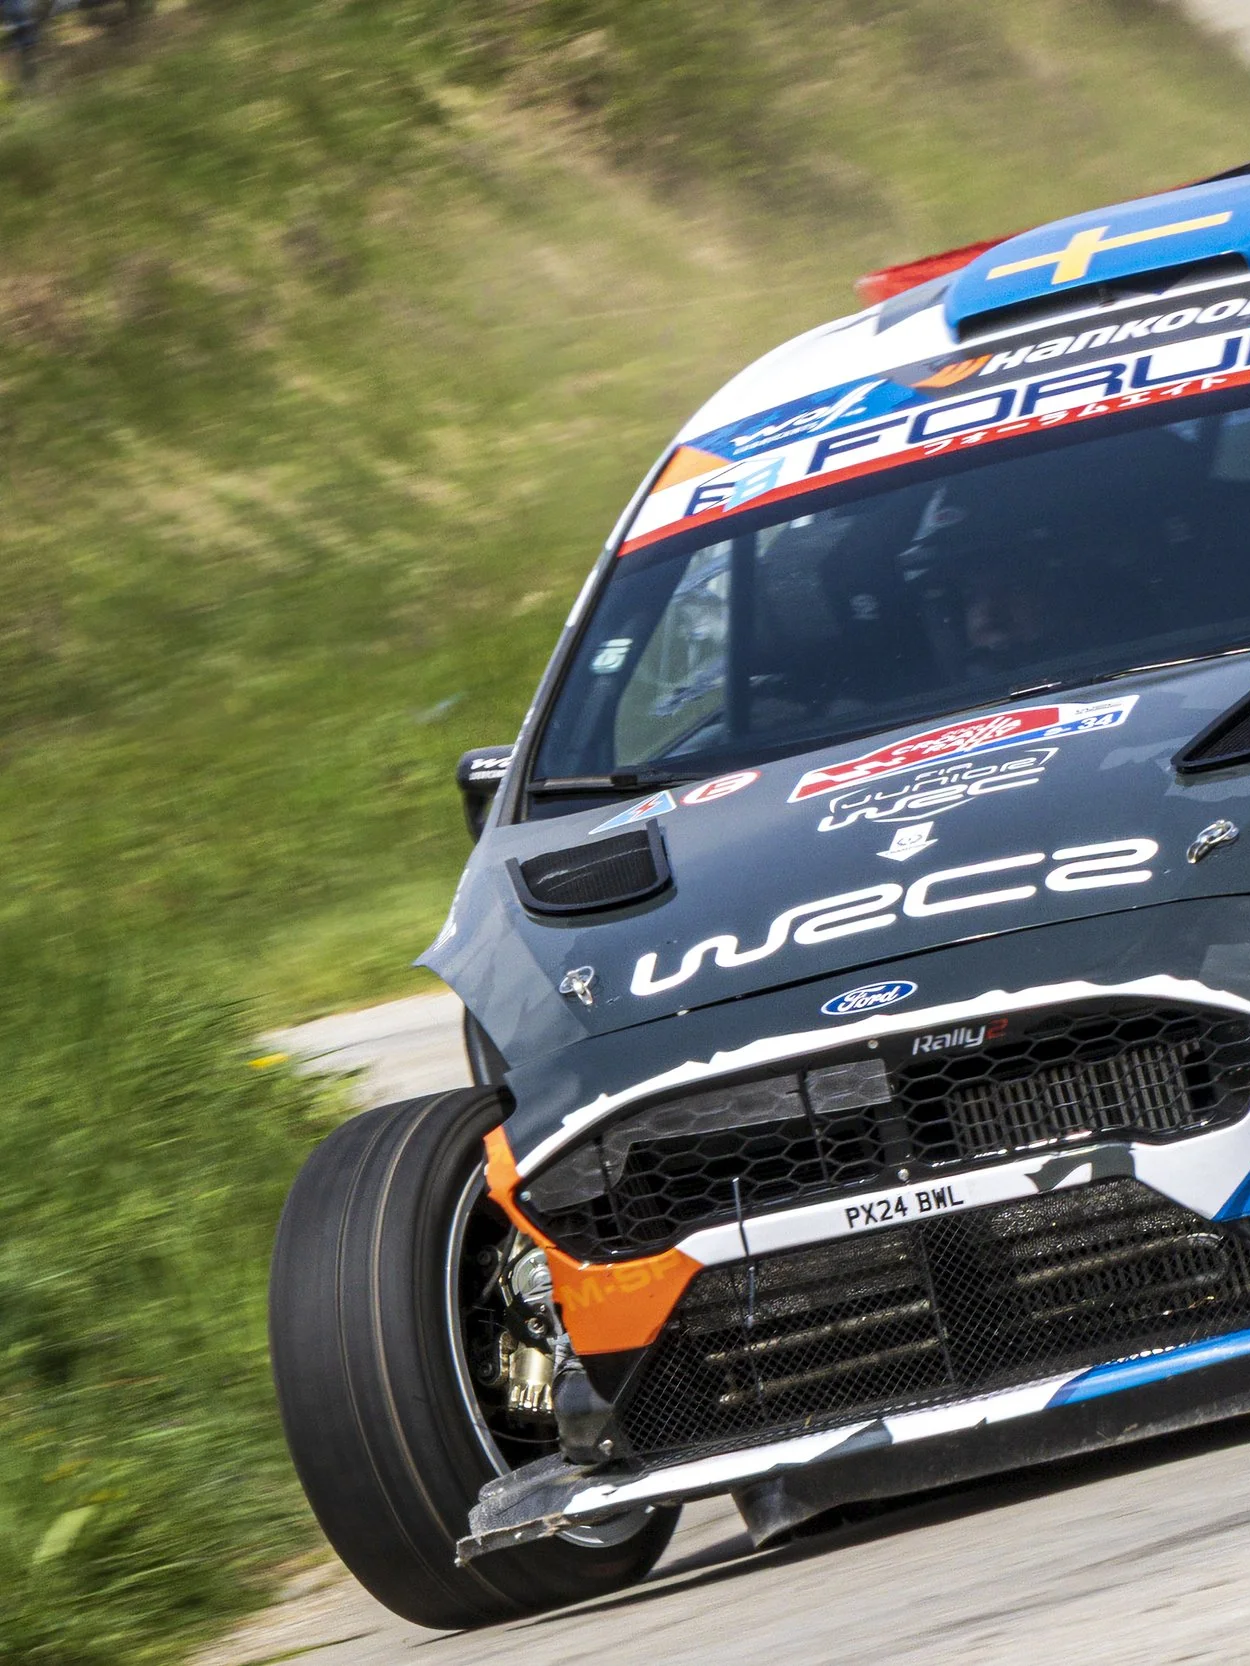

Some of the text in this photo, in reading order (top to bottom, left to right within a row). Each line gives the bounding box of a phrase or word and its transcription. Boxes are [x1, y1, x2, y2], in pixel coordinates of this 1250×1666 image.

[923, 377, 1228, 455] フォーラムエイト
[1080, 712, 1114, 731] 34
[817, 766, 1046, 833] WRC
[630, 838, 1159, 997] WRC2
[837, 985, 901, 1013] Ford
[911, 1018, 1009, 1056] Rally2
[844, 1185, 965, 1229] PX24 BWL
